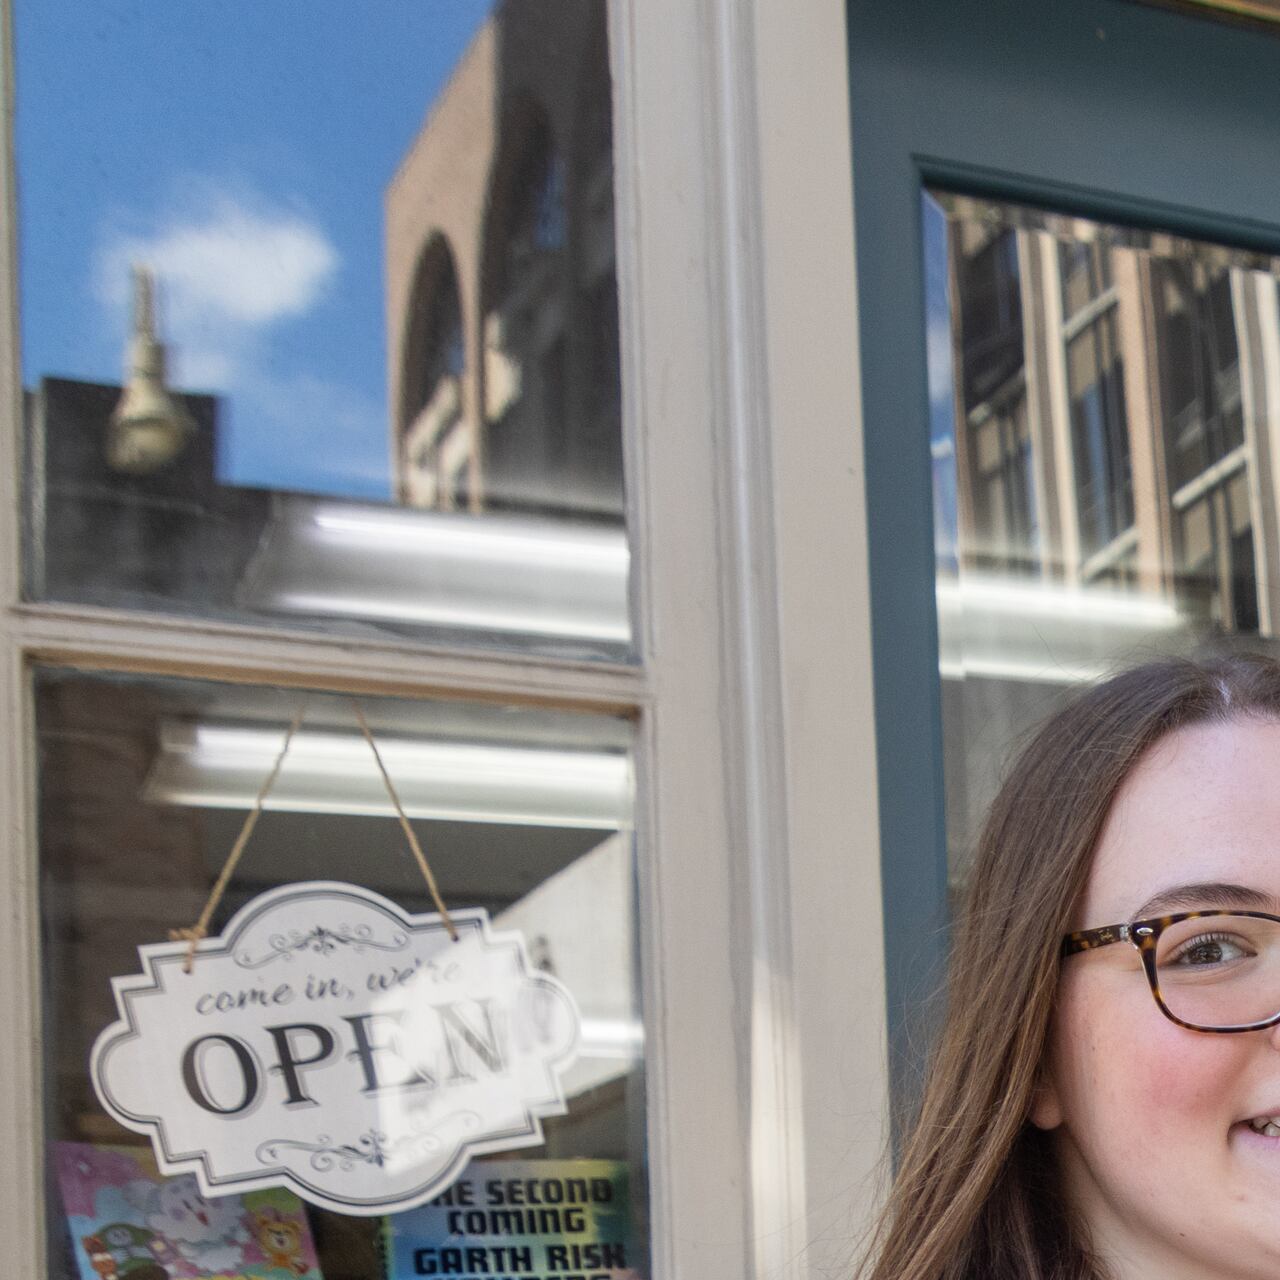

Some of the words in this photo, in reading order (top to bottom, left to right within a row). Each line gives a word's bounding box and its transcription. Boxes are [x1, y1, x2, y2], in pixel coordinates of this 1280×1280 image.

[195, 976, 294, 1016] come
[304, 974, 356, 1000] in,
[180, 1000, 507, 1118] OPEN
[431, 1179, 473, 1207] HE
[486, 1178, 613, 1206] SECOND
[448, 1208, 585, 1235] COMING
[413, 1246, 533, 1275] GARTH
[546, 1242, 627, 1272] RISK
